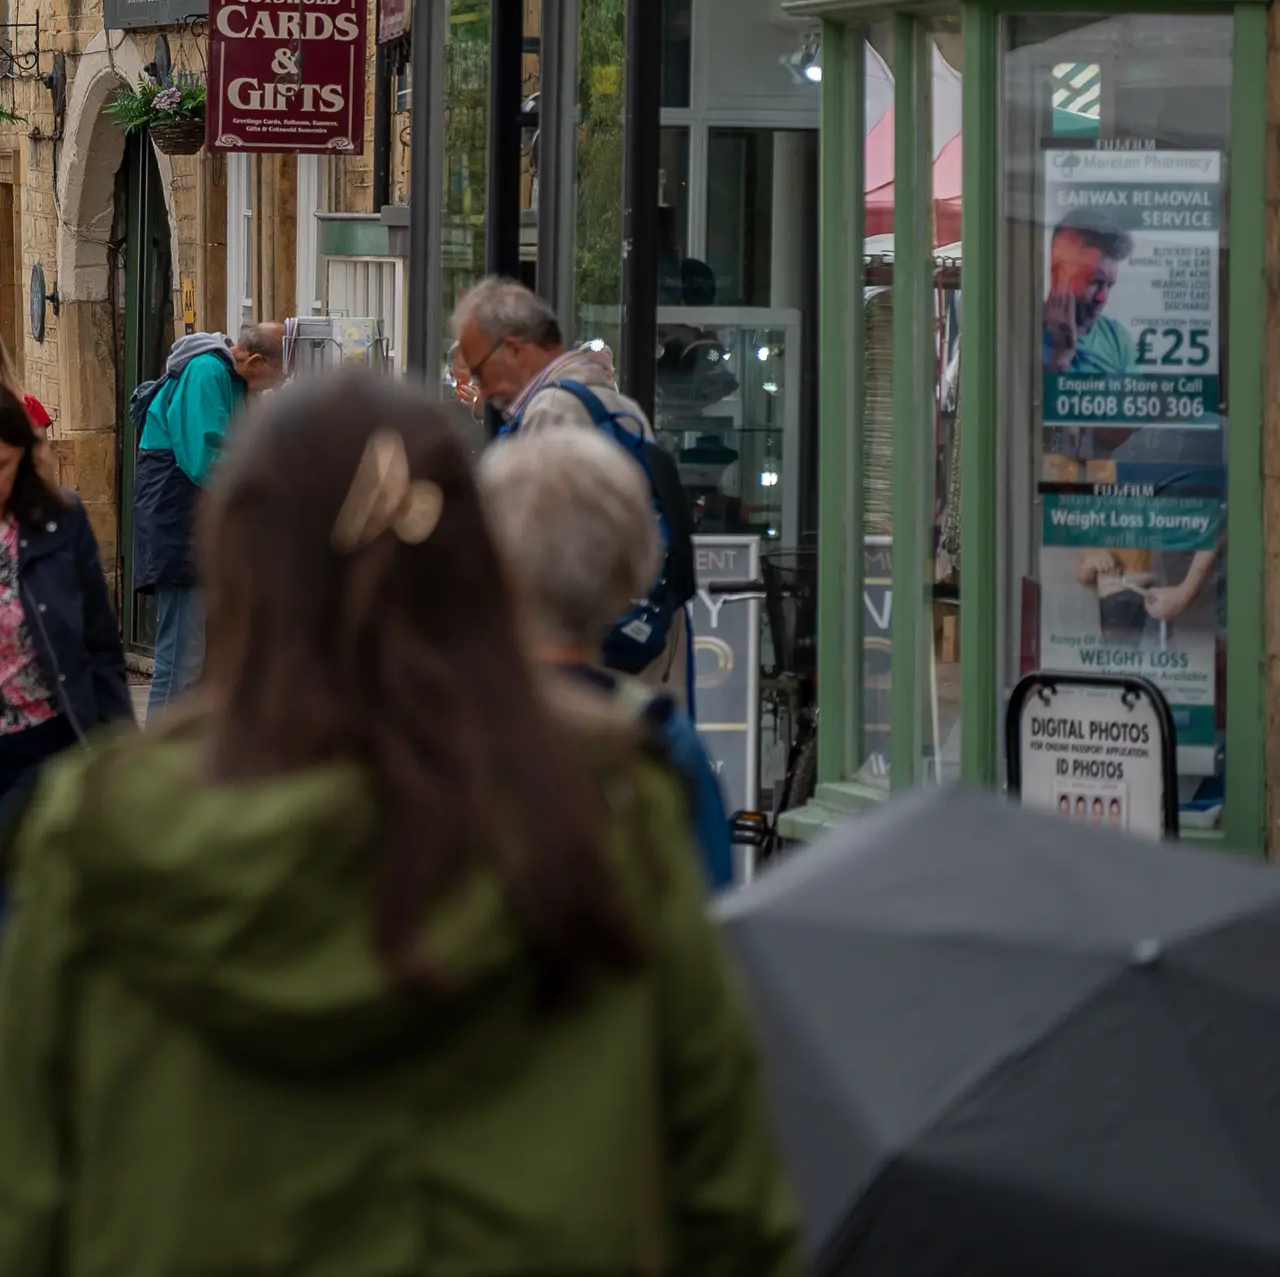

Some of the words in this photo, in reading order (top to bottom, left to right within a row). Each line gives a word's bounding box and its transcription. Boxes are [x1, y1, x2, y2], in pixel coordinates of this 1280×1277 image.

[216, 5, 359, 41] CARDS
[271, 47, 300, 74] &
[227, 77, 345, 113] GIFTS
[1144, 154, 1212, 173] Pharmacy
[1057, 189, 1128, 206] EARWAX
[1132, 190, 1213, 206] REMOVAL
[1142, 210, 1213, 227] SERVICE
[1165, 301, 1211, 311] DISCHARGE
[1135, 328, 1211, 366] £25
[1058, 377, 1106, 395] Enquire
[1124, 378, 1158, 392] Store
[1161, 382, 1175, 392] or
[1178, 378, 1203, 392] Call
[1056, 395, 1117, 415] 01608
[1123, 396, 1161, 416] 650
[1166, 396, 1204, 416] 306
[1050, 509, 1106, 530] Weight
[1110, 511, 1144, 528] Loss
[1149, 512, 1210, 533] Journey
[1080, 649, 1146, 667] WEIGHT
[1150, 650, 1189, 668] LOSS
[1032, 717, 1085, 740] DIGITAL
[1089, 720, 1150, 744] PHOTOS
[1030, 741, 1043, 750] FOR
[1071, 743, 1104, 755] PASSPORT
[1105, 746, 1150, 758] APPLICATION
[1056, 758, 1069, 775] ID
[1072, 759, 1124, 780] PHOTOS
